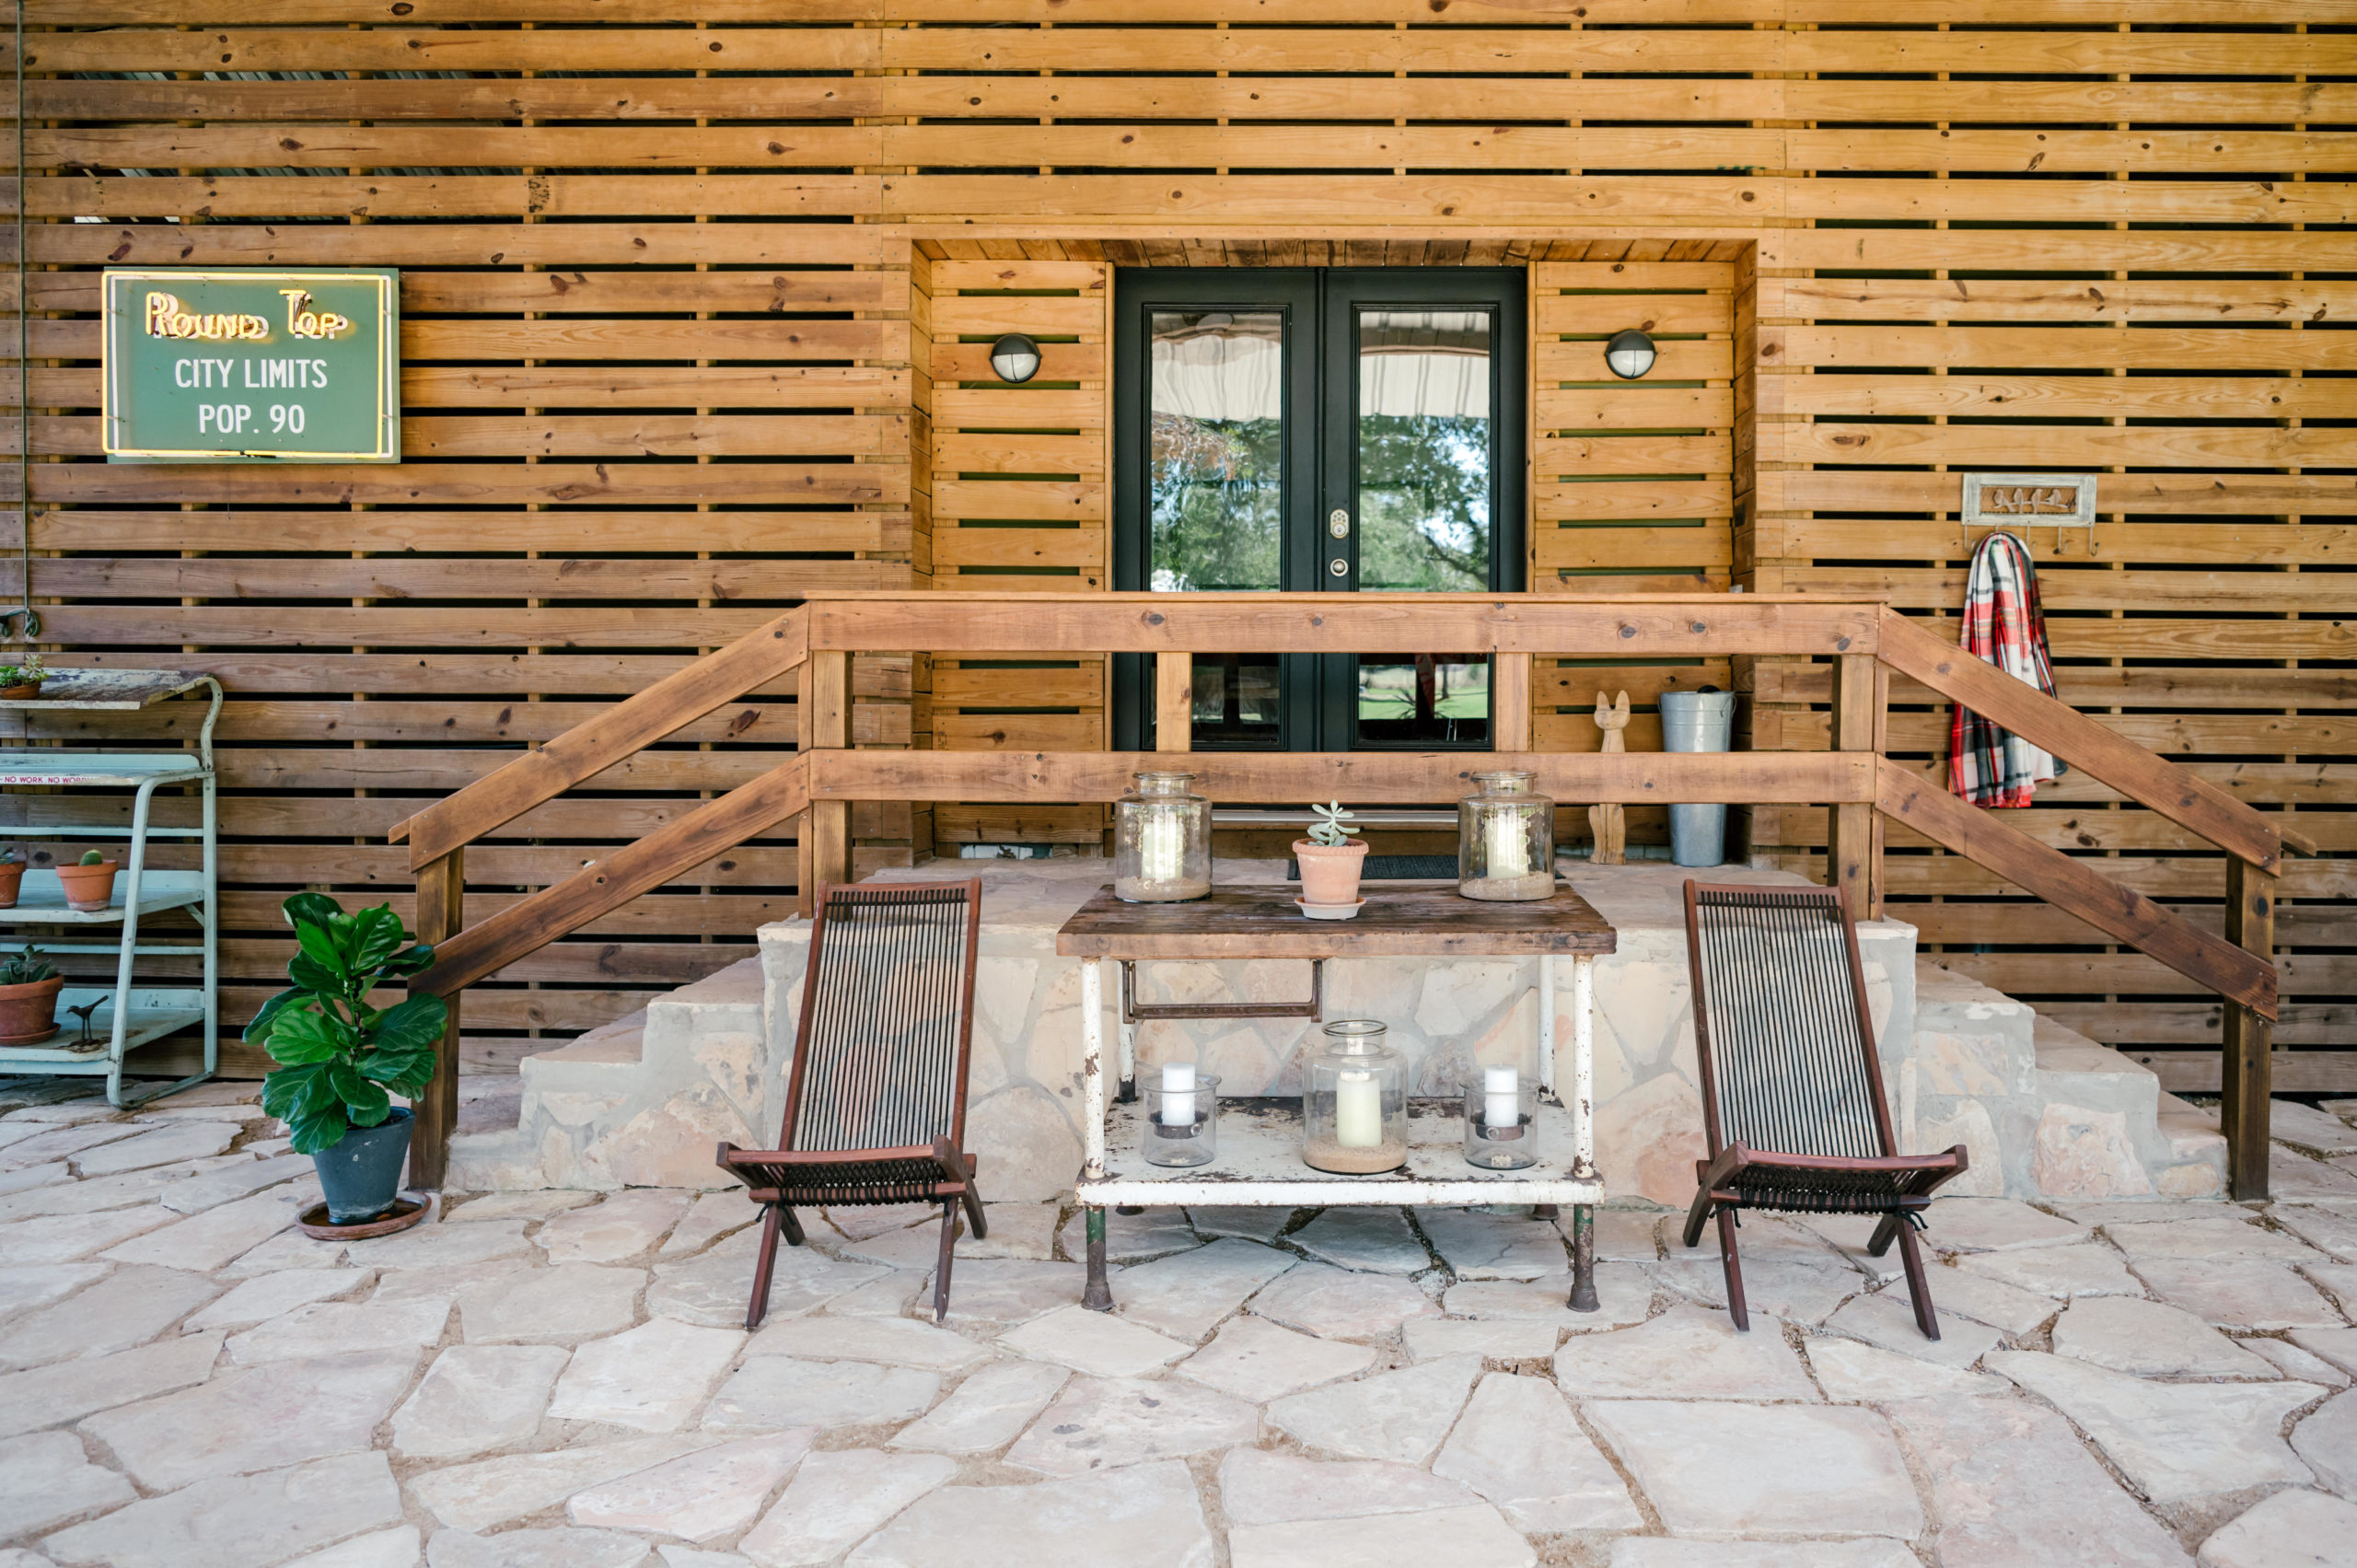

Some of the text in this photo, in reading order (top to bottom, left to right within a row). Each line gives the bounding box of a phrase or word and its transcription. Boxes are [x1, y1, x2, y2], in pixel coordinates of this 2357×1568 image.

[175, 359, 327, 388] CITY LIMITS
[199, 405, 305, 433] POP. 90
